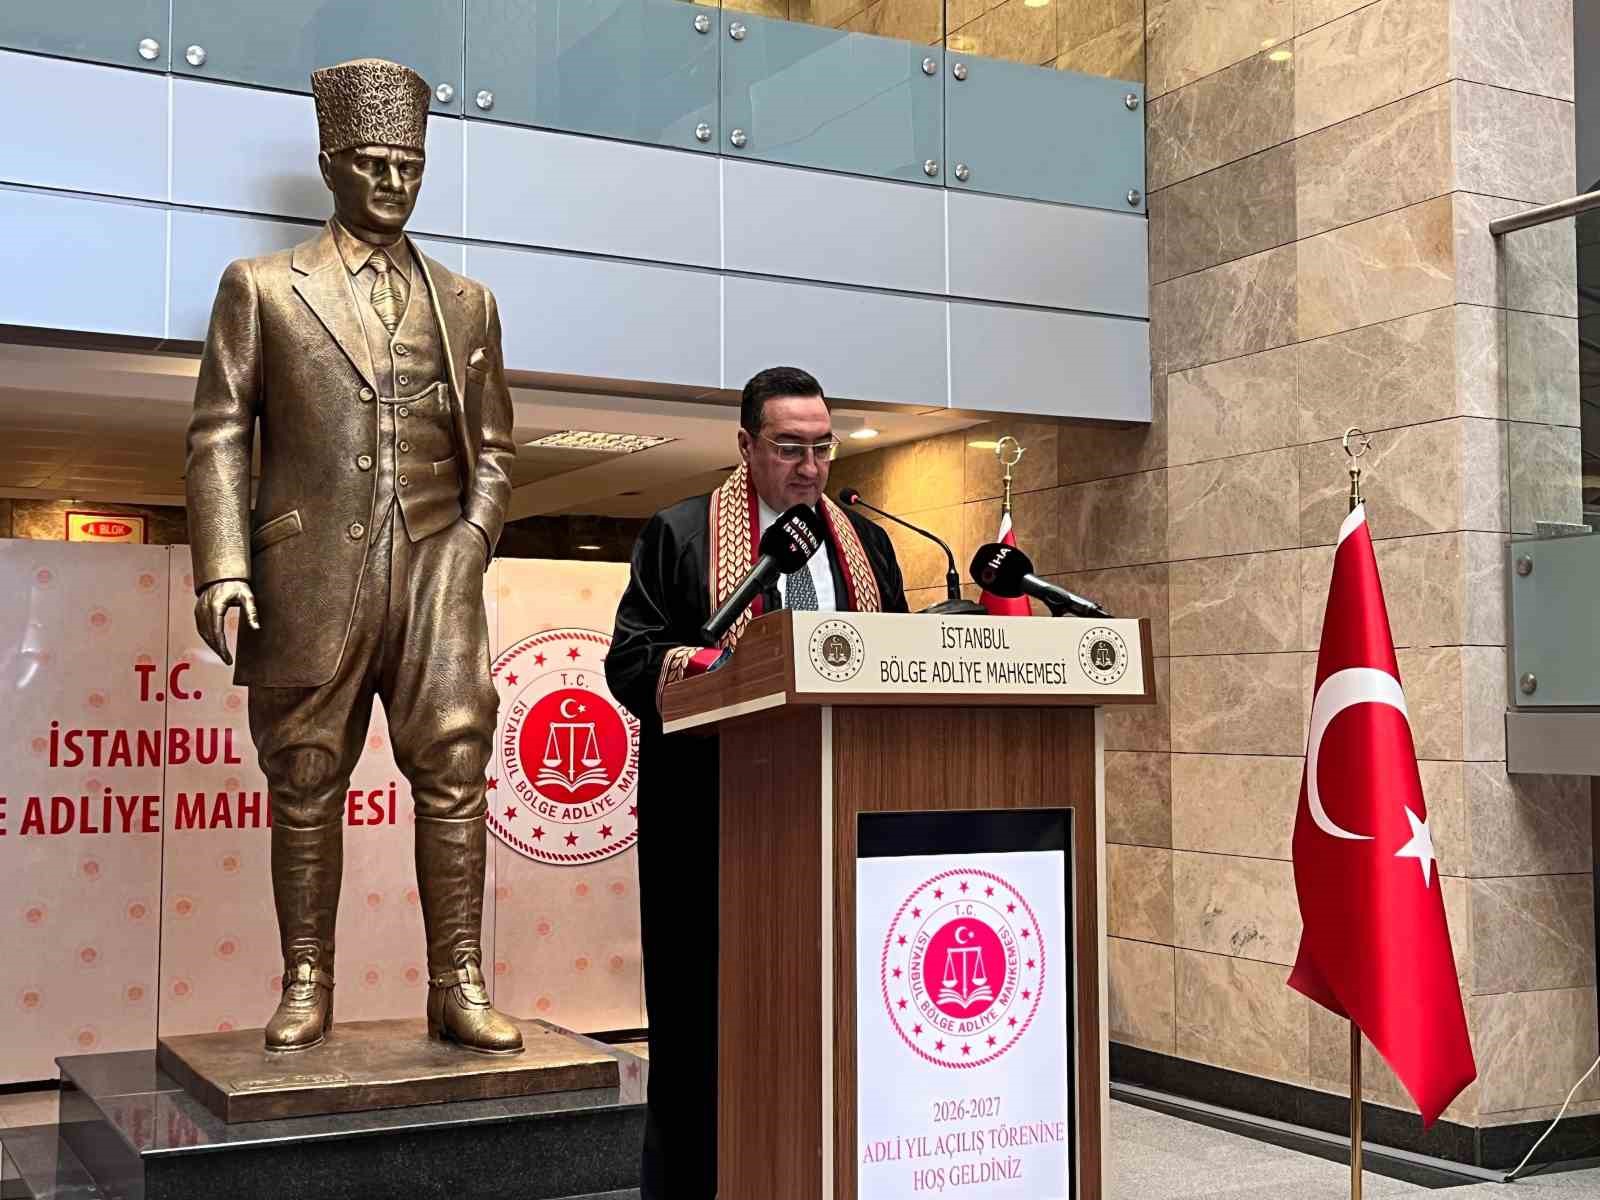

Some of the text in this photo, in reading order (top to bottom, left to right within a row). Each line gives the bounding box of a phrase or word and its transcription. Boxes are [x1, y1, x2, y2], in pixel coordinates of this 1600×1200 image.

[87, 524, 125, 535] A BLOK
[941, 621, 1010, 650] İSTANBUL
[135, 663, 202, 702] T.C.
[561, 673, 589, 688] T.C.
[880, 656, 928, 683] BÖLGE
[932, 656, 982, 684] ADLİYE
[986, 658, 1067, 685] MAHKEMESİ
[49, 720, 242, 767] İSTANBUL
[19, 787, 161, 835] ADLİYE
[174, 781, 397, 830] MAHESİ
[561, 794, 615, 820] ADLİYE
[933, 1096, 1001, 1122] 2026-2027
[863, 1119, 1065, 1163] ADLİ YIL AÇILIŞ TÖRENİNE
[913, 1155, 1022, 1192] HOŞ GELDİNİZ
